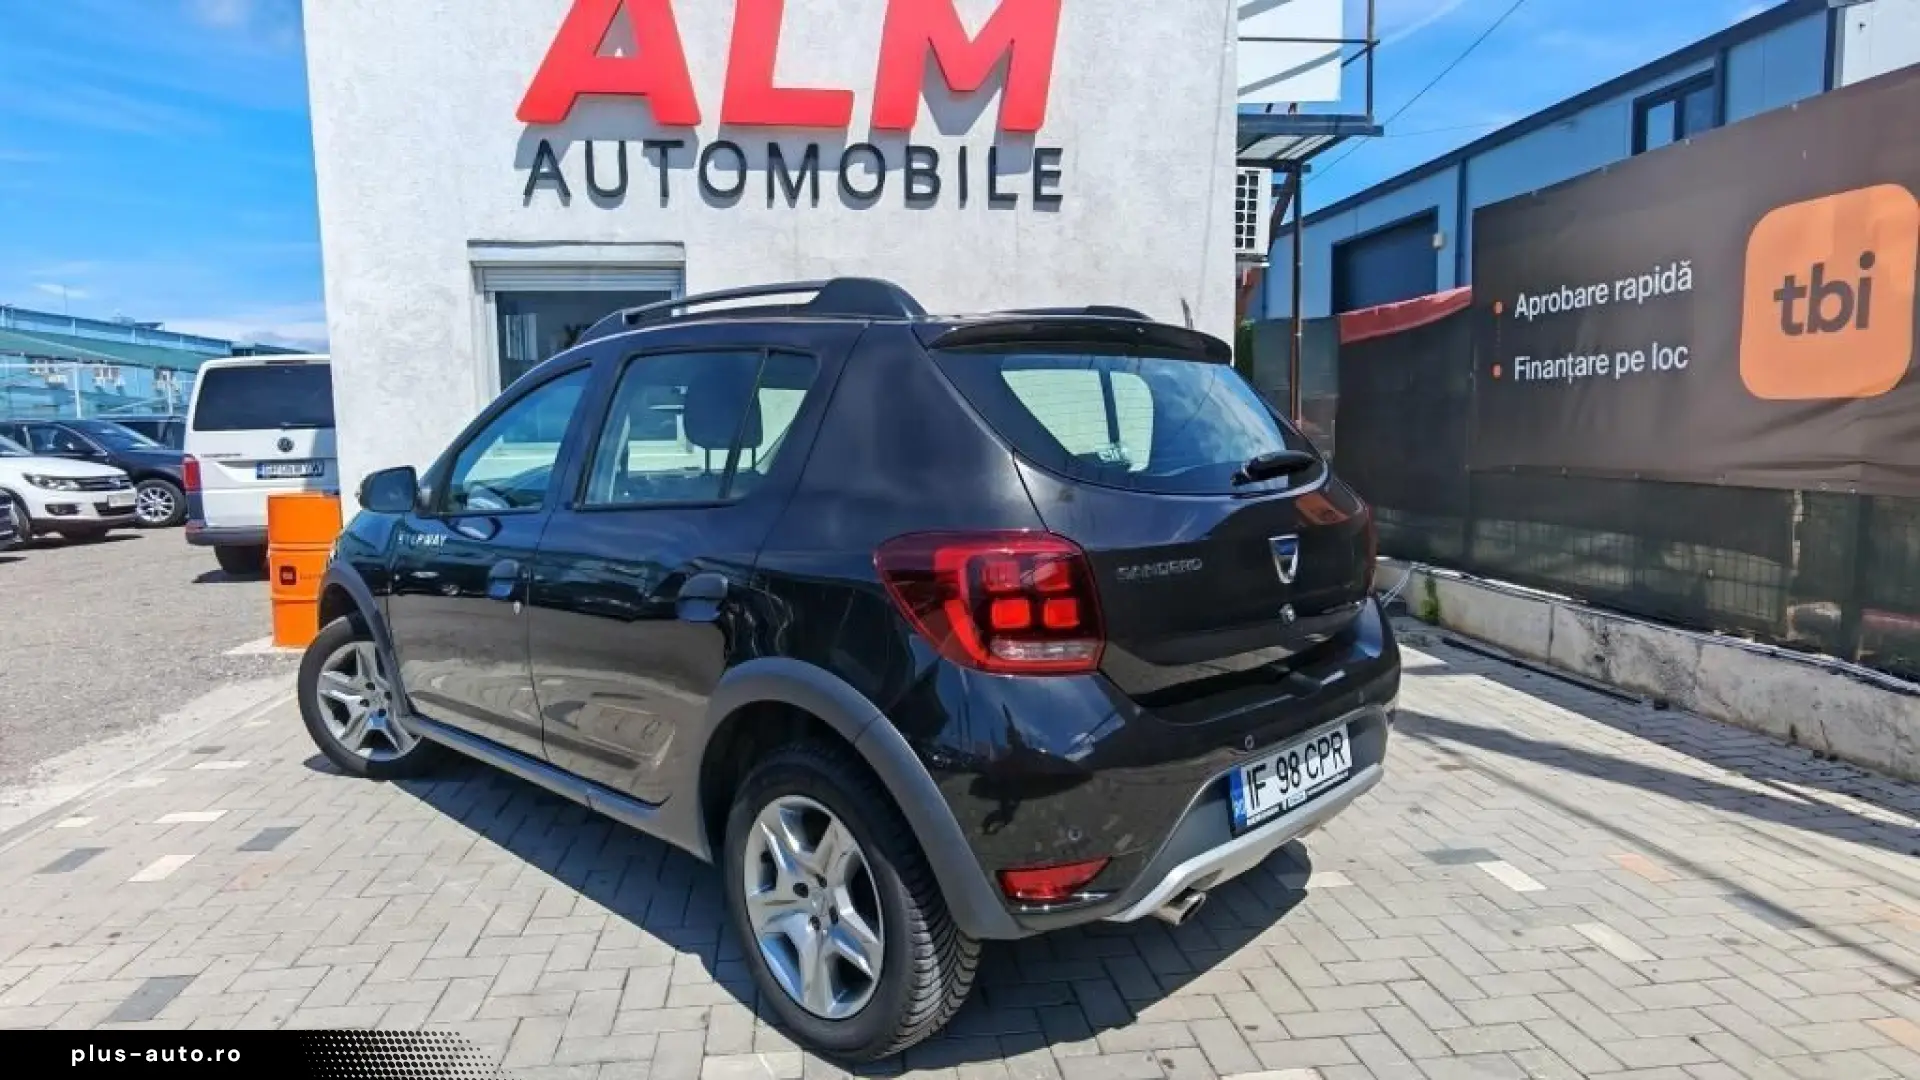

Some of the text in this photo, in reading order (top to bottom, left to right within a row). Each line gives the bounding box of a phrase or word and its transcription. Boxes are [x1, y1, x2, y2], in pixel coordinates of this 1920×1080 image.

[515, 0, 1062, 131] ALM
[523, 140, 1063, 204] AUTOMOBILE
[1515, 260, 1692, 321] Aprobare rapidă
[1773, 251, 1876, 336] tbi
[1514, 341, 1689, 384] Finanțare pe loc
[1117, 558, 1202, 580] SANDERO
[1246, 730, 1345, 810] IF 98 CPR
